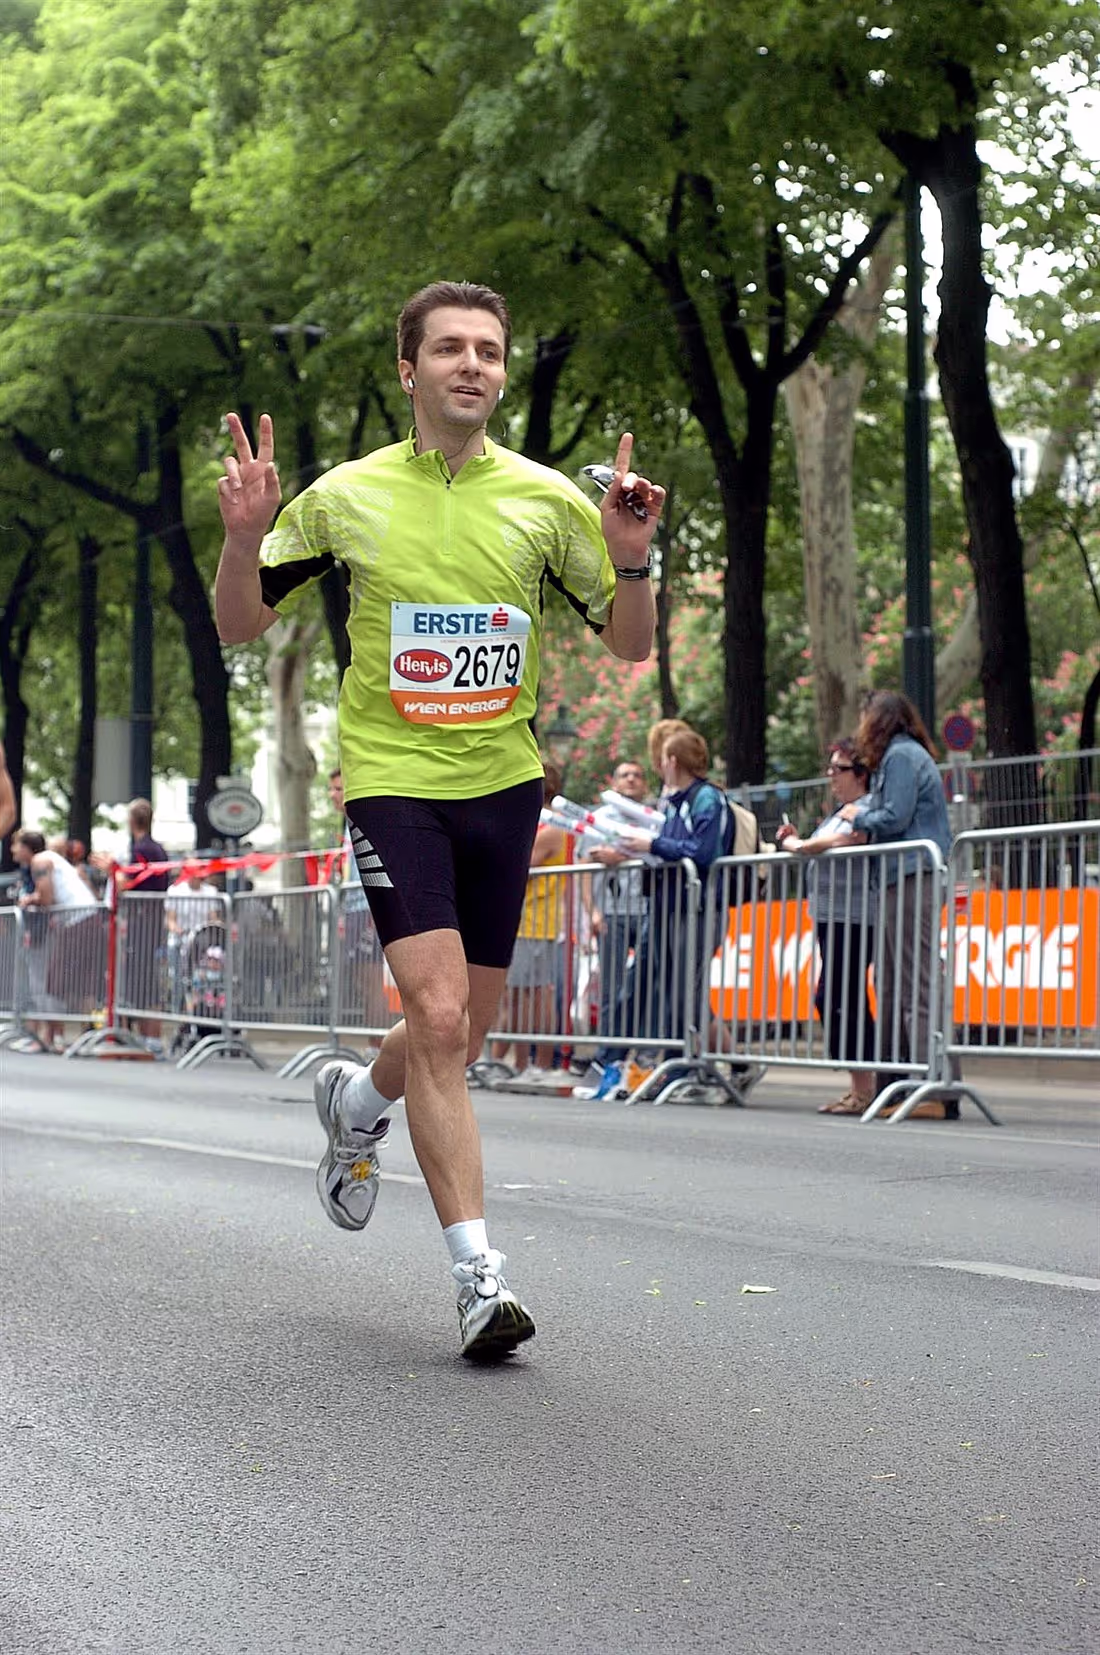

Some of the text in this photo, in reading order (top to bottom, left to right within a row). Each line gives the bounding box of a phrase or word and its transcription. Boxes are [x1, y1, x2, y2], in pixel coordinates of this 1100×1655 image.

[414, 612, 488, 635] ERSTE
[400, 655, 448, 677] Hervis
[453, 643, 520, 687] 2679
[404, 697, 510, 715] WIEN ENERGIE
